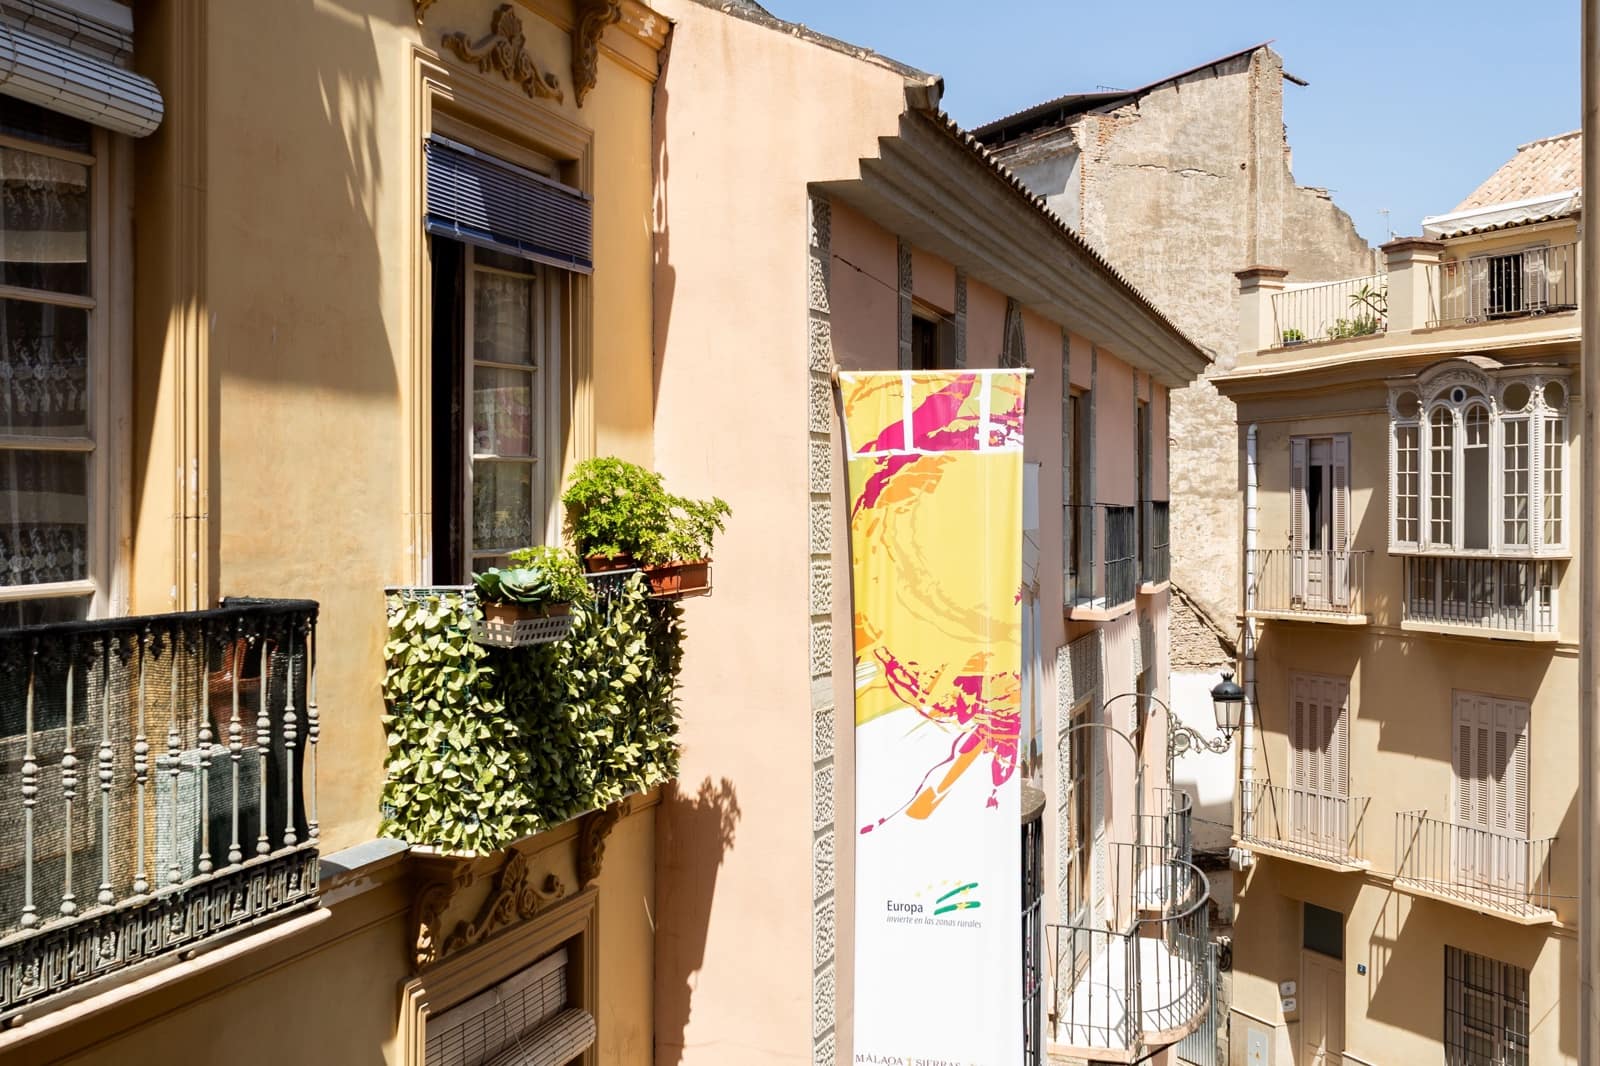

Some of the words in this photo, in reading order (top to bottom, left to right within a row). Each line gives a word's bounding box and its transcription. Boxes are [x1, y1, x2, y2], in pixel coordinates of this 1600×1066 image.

[887, 900, 924, 915] Europa
[886, 915, 913, 925] invierte
[914, 917, 923, 925] en
[924, 916, 934, 926] las
[935, 919, 956, 927] zonas
[957, 919, 982, 929] rurales
